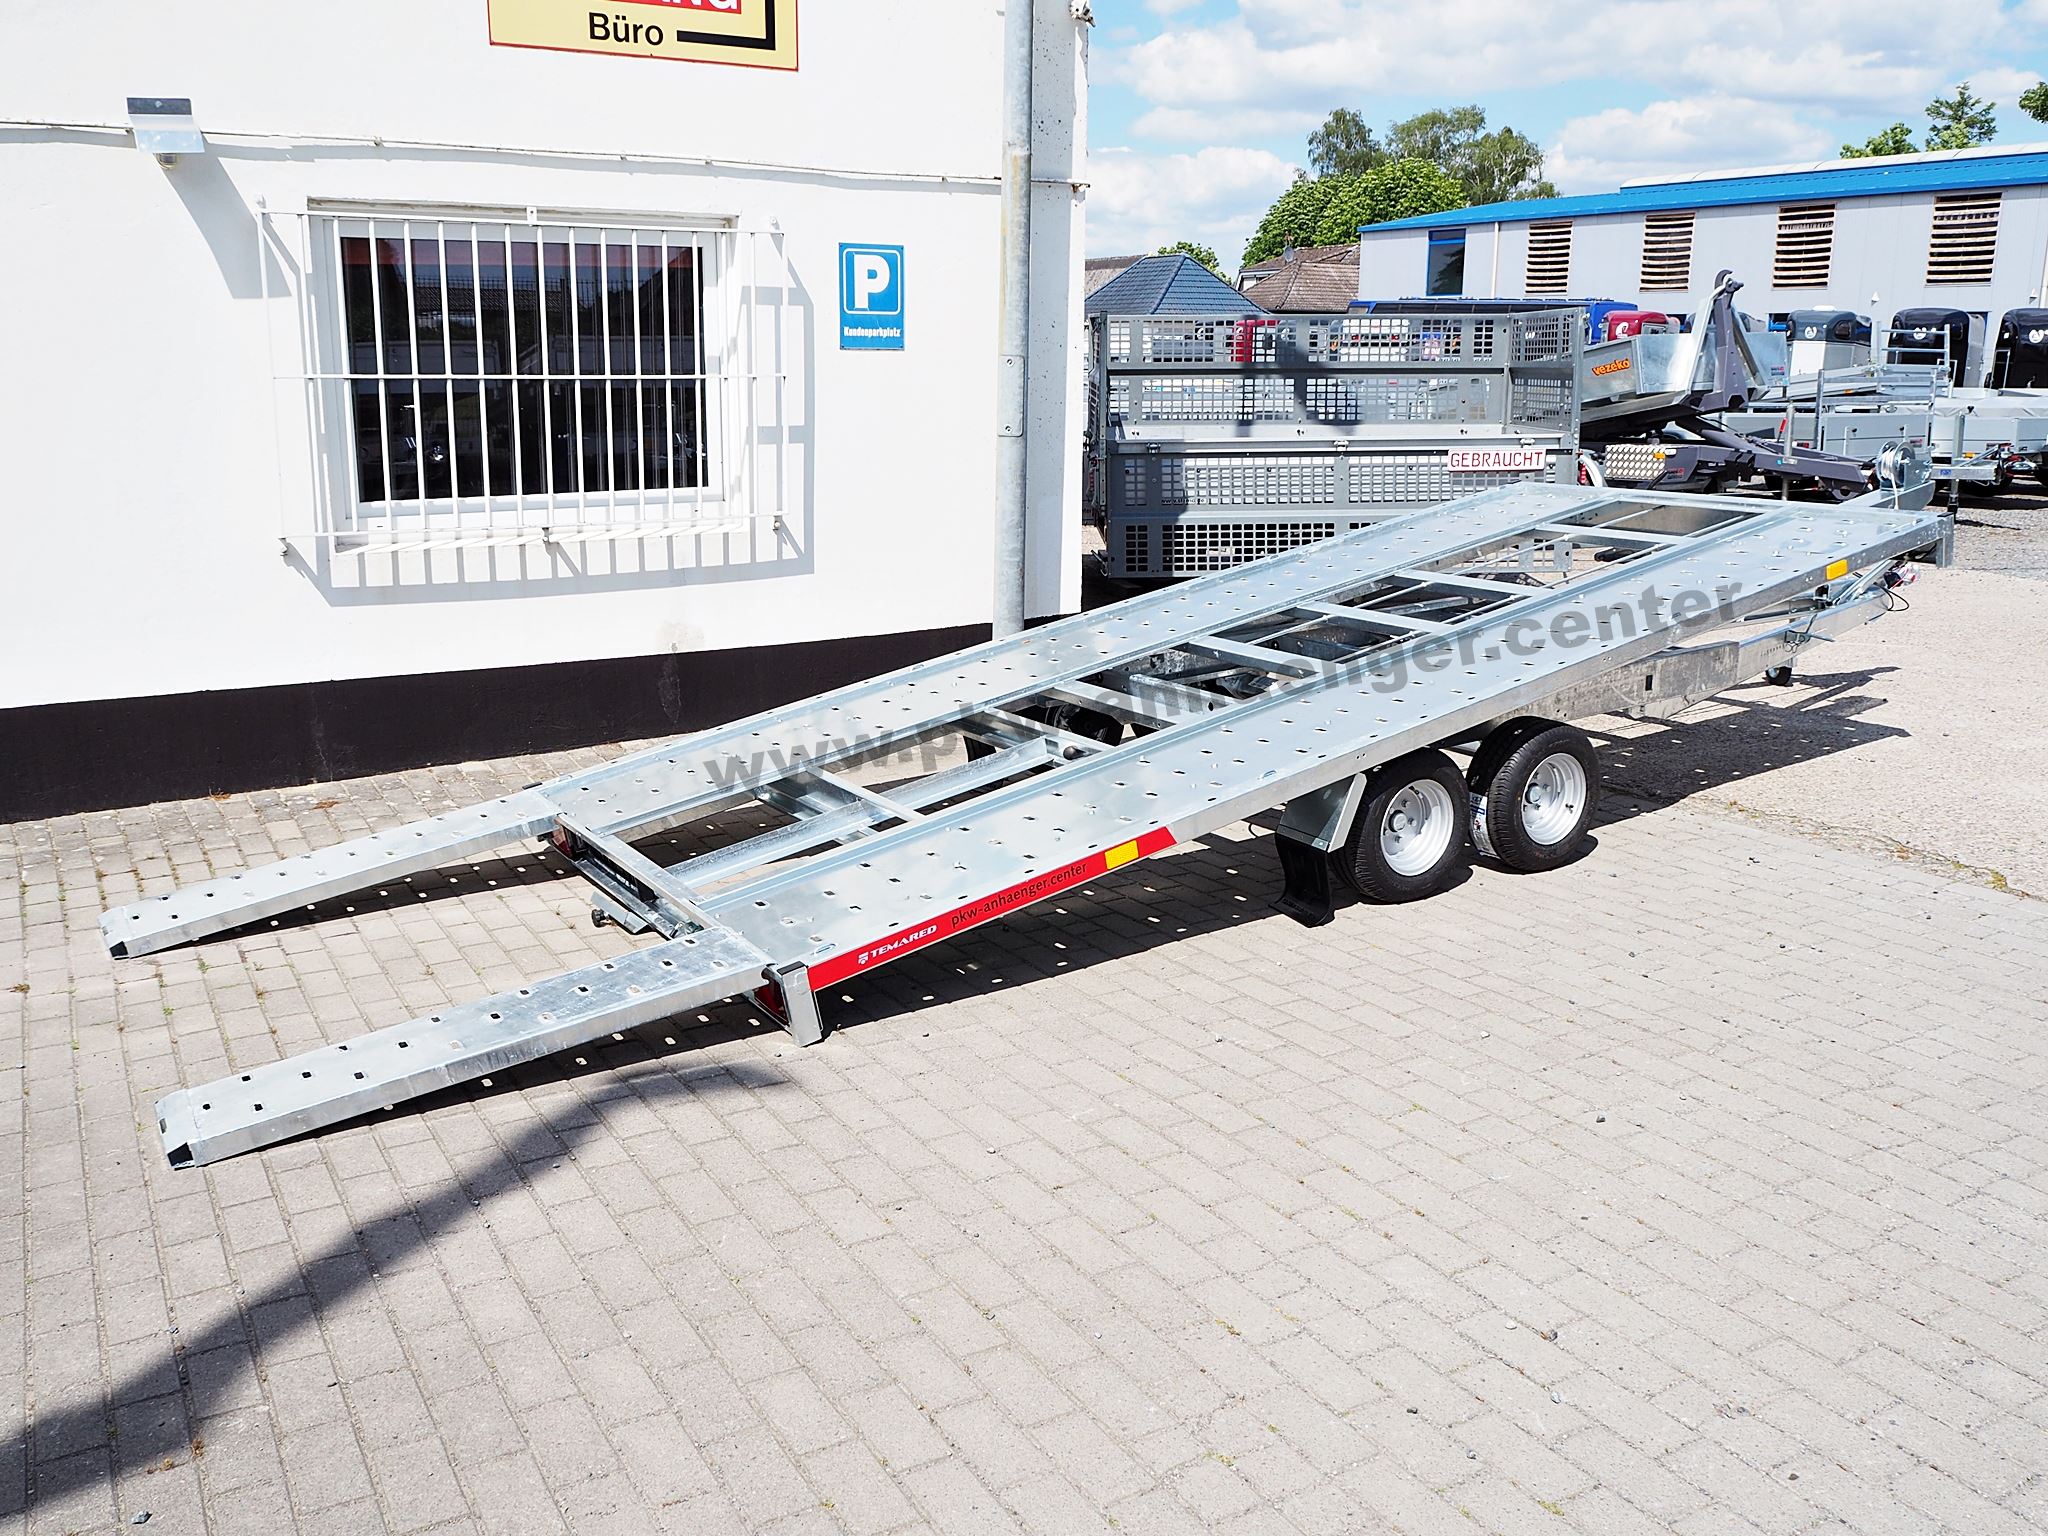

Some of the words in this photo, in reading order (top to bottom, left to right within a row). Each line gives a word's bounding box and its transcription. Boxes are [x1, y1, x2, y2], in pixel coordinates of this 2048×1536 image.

[588, 12, 664, 46] Büro
[853, 254, 890, 309] P
[843, 326, 901, 338] Kundenparkplatz
[1592, 358, 1631, 376] vezeko
[1450, 452, 1543, 468] GEBRAUCHT
[950, 863, 1087, 928] pkw-anhaenger.center
[871, 925, 937, 958] TEMARED
